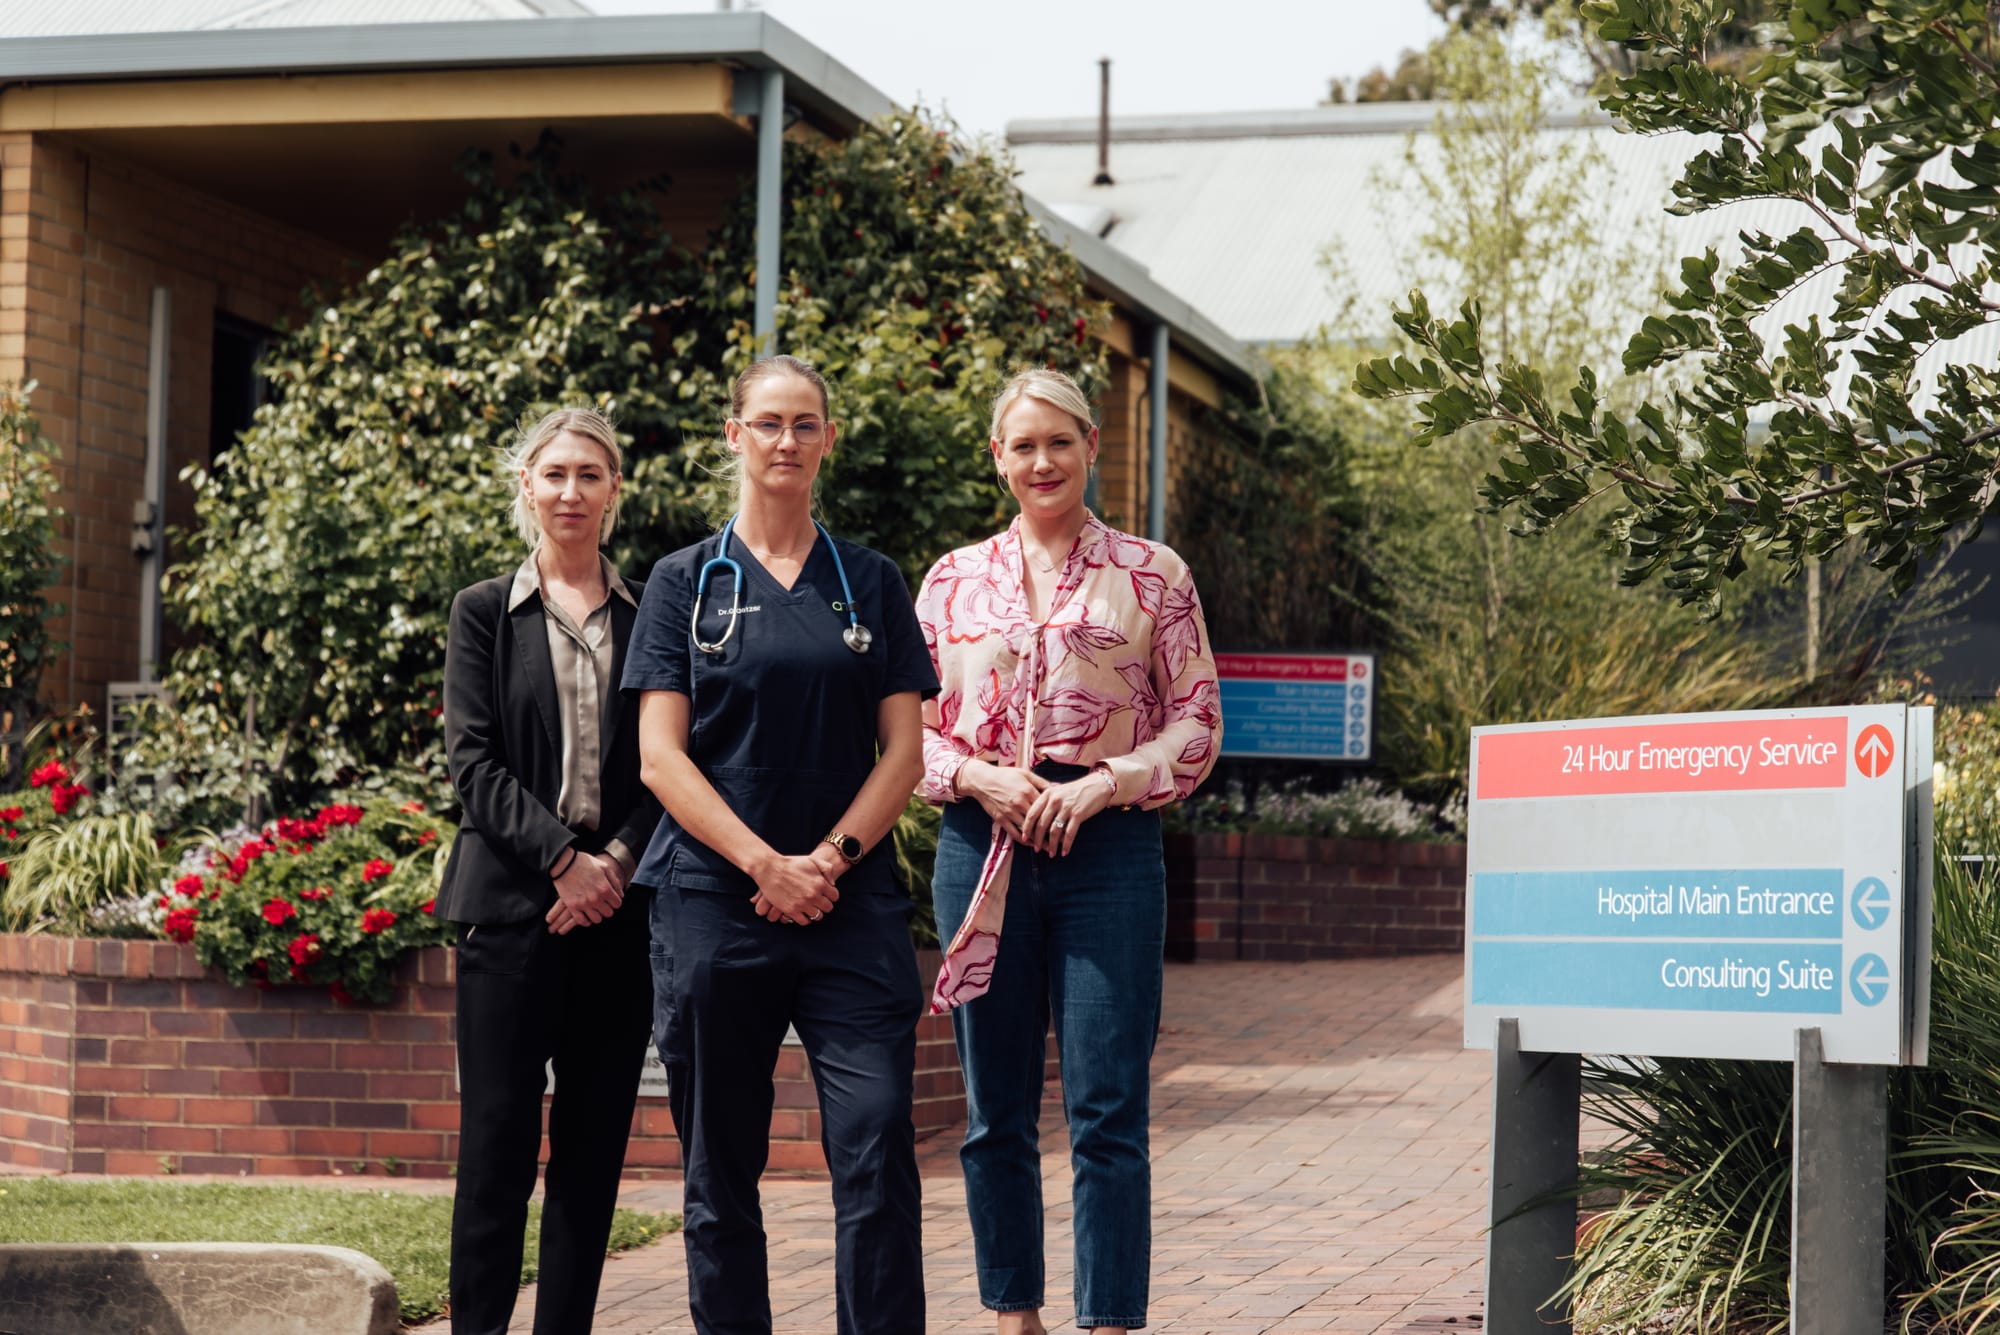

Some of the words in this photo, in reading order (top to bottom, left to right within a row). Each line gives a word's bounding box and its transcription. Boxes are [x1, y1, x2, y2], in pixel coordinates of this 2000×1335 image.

[1255, 662, 1308, 676] Emergency
[1311, 662, 1345, 674] Service
[1561, 745, 1585, 773] 24
[1589, 743, 1635, 772] Hour
[1638, 741, 1753, 776] Emergency
[1759, 734, 1838, 767] Service
[1598, 884, 1673, 922] Hospital
[1678, 885, 1730, 915] Main
[1737, 885, 1834, 915] Entrance
[1661, 958, 1771, 997] Consulting
[1777, 959, 1834, 990] Suite
